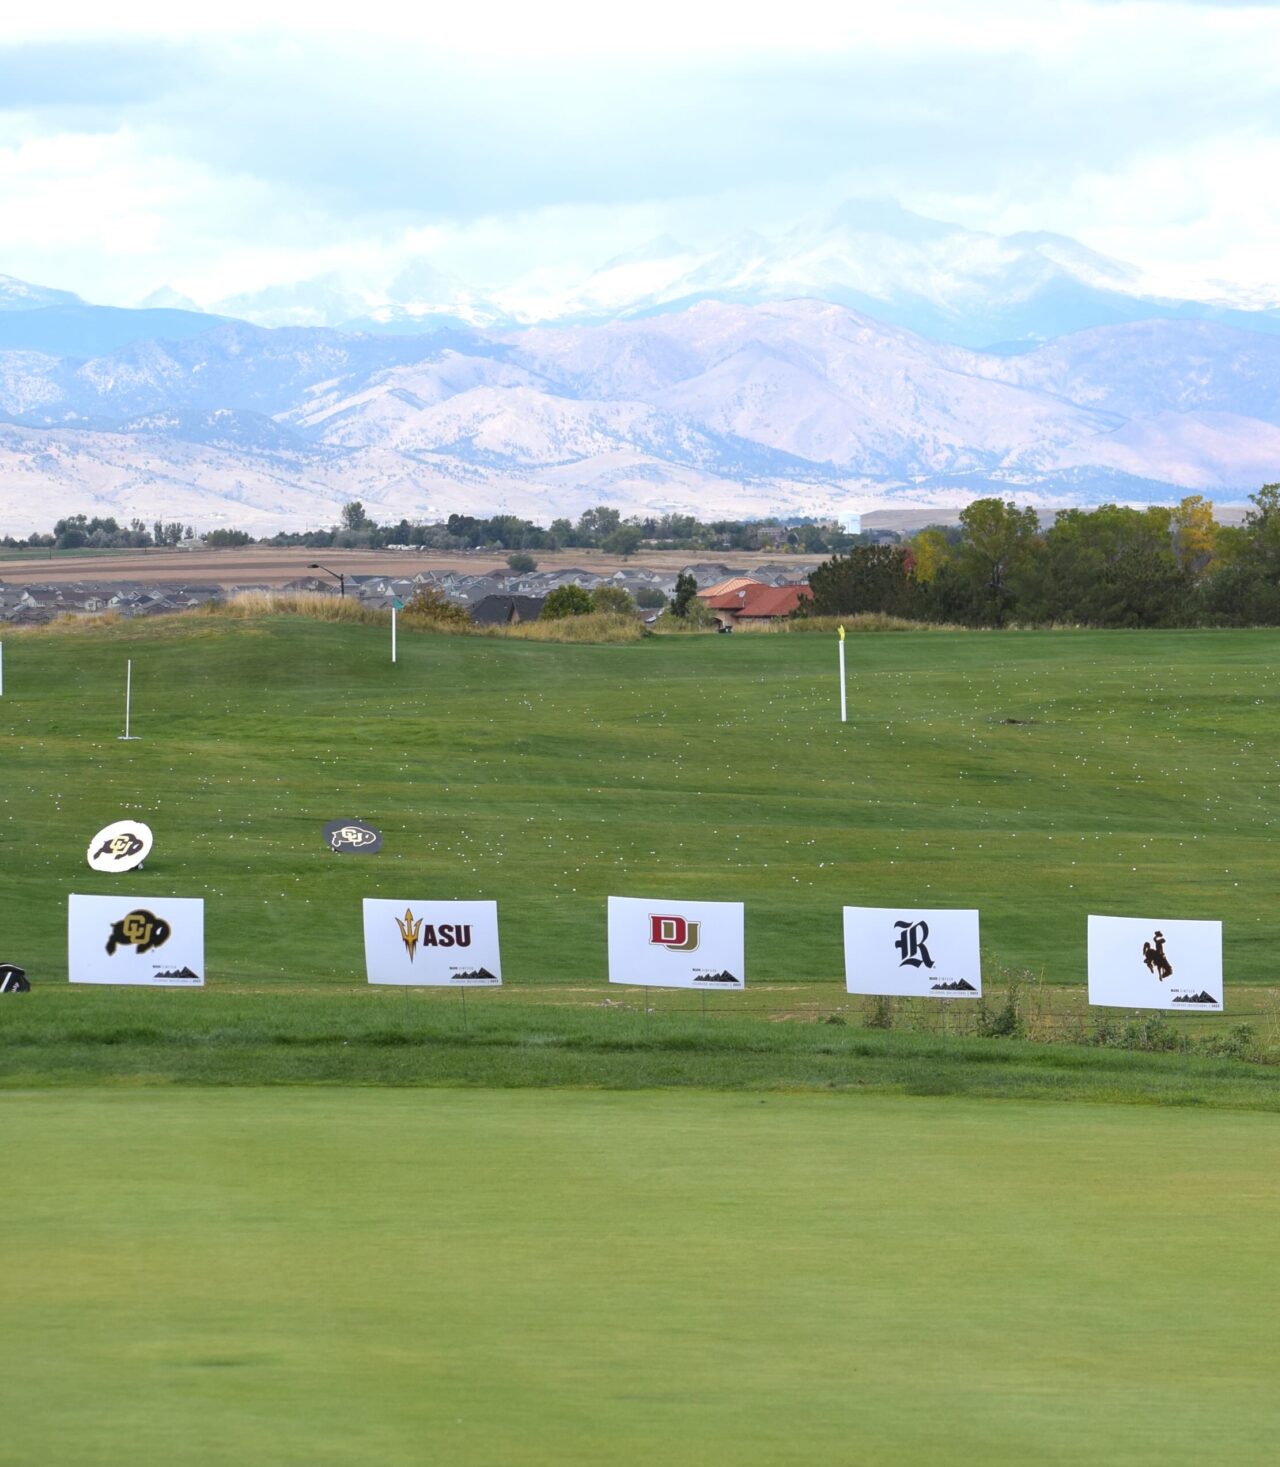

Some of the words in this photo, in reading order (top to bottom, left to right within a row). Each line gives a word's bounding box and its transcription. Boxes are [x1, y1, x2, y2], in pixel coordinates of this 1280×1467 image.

[122, 914, 154, 944] CU
[423, 924, 472, 947] ASU
[893, 920, 935, 969] R
